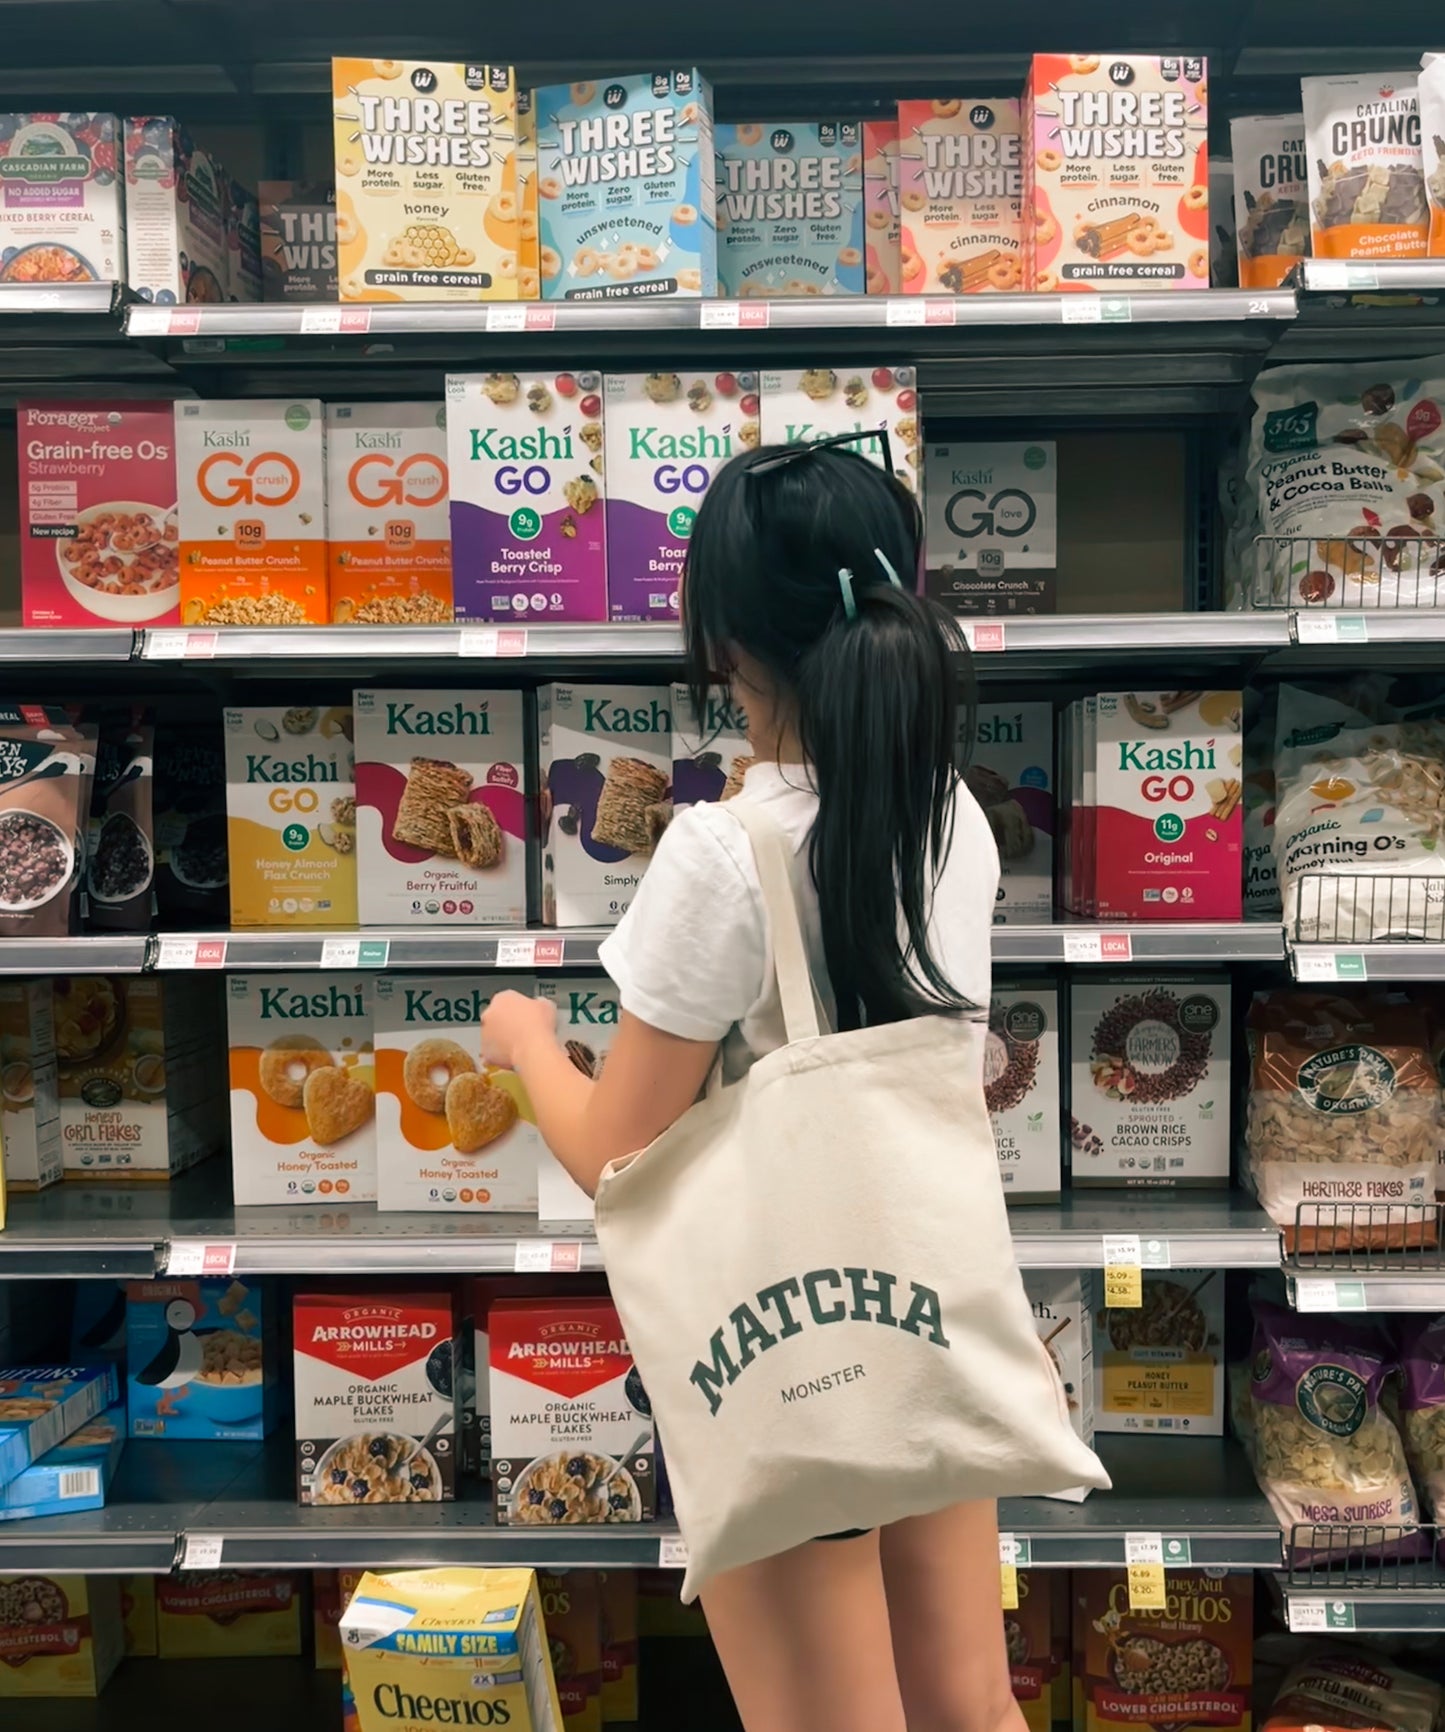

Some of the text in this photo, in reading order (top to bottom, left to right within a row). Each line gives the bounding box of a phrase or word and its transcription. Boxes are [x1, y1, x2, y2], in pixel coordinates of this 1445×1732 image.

[468, 68, 482, 78] 8g
[492, 68, 505, 80] 3g
[1059, 91, 1185, 126] THREE
[1356, 98, 1417, 118] CATALINA
[358, 97, 490, 135] THREE
[559, 108, 676, 155] THREE
[1332, 114, 1421, 156] CRUNC
[1060, 129, 1184, 157] WISHES
[361, 134, 491, 167] WISHES
[922, 134, 1021, 168] THRE
[2, 162, 86, 172] CASCADIAN FARM
[561, 146, 676, 186] WISHES
[367, 170, 393, 178] More
[724, 157, 841, 192] THREE
[8, 187, 80, 196] NO ADDED SUGAR
[607, 186, 631, 195] Zero
[404, 204, 449, 216] honey
[726, 192, 842, 221] WISHES
[1087, 197, 1160, 213] cinnamon
[27, 213, 56, 222] BERRY
[59, 213, 95, 222] CEREAL
[576, 216, 664, 245] unsweetened
[950, 233, 1020, 250] cinnamon
[1359, 230, 1419, 246] Chocolate
[1350, 240, 1428, 258] Peanut Butte
[742, 253, 830, 278] unsweetened
[1072, 265, 1176, 277] grain free cereal
[375, 272, 482, 285] grain free cereal
[1249, 301, 1269, 313] 24
[27, 410, 98, 427] Forager
[1269, 411, 1311, 436] 365
[203, 430, 251, 447] Kashi
[355, 431, 402, 449] Kashi
[470, 425, 574, 460] Kashi
[628, 424, 732, 459] Kashi
[27, 441, 168, 460] Grain-free Os
[28, 462, 105, 476] Strawberry
[1261, 452, 1322, 478] Organic
[197, 451, 300, 508] GO
[256, 475, 289, 486] crush
[494, 465, 551, 495] GO
[653, 465, 709, 495] GO
[951, 467, 994, 486] Kashi
[1266, 461, 1388, 497] Peanut Butter
[1269, 477, 1394, 512] & Cocoa Balls
[1001, 508, 1023, 519] love
[518, 514, 533, 528] 9g
[32, 528, 75, 537] New recipe
[238, 525, 261, 537] 10g
[201, 556, 301, 565] Peanut Butter Crunch
[500, 548, 551, 560] Toasted
[491, 561, 563, 576] Berry Crisp
[953, 580, 1029, 590] Chocolate Crunch
[386, 701, 491, 735] Kashi
[583, 699, 671, 733] Kash
[1118, 738, 1216, 770] Kashi
[246, 753, 339, 783] Kashi
[1141, 775, 1194, 802] GO
[269, 788, 319, 813] GO
[1161, 820, 1178, 831] 11g
[289, 829, 303, 842] 9g
[1285, 820, 1342, 850] Organic
[1286, 836, 1406, 866] Morning O's
[256, 859, 338, 871] Honey Almond
[1144, 853, 1193, 866] Original
[264, 870, 331, 880] Flax Crunch
[424, 871, 459, 880] Organic
[604, 875, 640, 887] Simply
[406, 880, 478, 893] Berry Fruitful
[536, 948, 558, 957] LOCAL
[1103, 942, 1127, 950] LOCAL
[198, 950, 221, 959] LOCAL
[260, 984, 365, 1018] Kashi
[569, 992, 618, 1024] Ka
[1128, 1037, 1176, 1052] FARMERS
[1301, 1048, 1355, 1079] NATURE'S
[1128, 1114, 1175, 1122] SPROUTED
[1116, 1124, 1186, 1134] BROWN RICE
[1111, 1136, 1192, 1146] CACAO CRISPS
[299, 1152, 335, 1161] Organic
[441, 1159, 476, 1168] Organic
[277, 1160, 357, 1173] Honey Toasted
[420, 1168, 498, 1181] Honey Toasted
[206, 1255, 228, 1264] LOCAL
[554, 1252, 576, 1261] LOCAL
[142, 1284, 182, 1297] ORIGINAL
[344, 1307, 400, 1320] ORGANIC
[312, 1323, 437, 1342] ARROWHEAD
[541, 1322, 600, 1337] ORGANIC
[352, 1339, 394, 1352] MILLS
[689, 1267, 950, 1417] MATCHA
[550, 1357, 592, 1369] MILLS
[1145, 1372, 1170, 1380] HONEY
[1303, 1369, 1345, 1394] NATURE'S
[348, 1384, 398, 1394] ORGANIC
[780, 1363, 866, 1404] MONSTER
[1128, 1381, 1188, 1390] PEANUT BUTTER
[313, 1392, 433, 1406] MAPLE BUCKWHEAT
[353, 1406, 394, 1416] FLAKES
[545, 1402, 595, 1411] ORGANIC
[510, 1411, 632, 1424] MAPLE BUCKWHEAT
[550, 1424, 592, 1434] FLAKES
[1200, 1579, 1223, 1593] Nut
[420, 1615, 476, 1626] Cheerios
[396, 1633, 498, 1655] FAMILY SIZE
[473, 1675, 490, 1685] 2X
[373, 1683, 511, 1726] Cheerios
[1102, 1700, 1239, 1714] LOWER CHOLESTEROL
